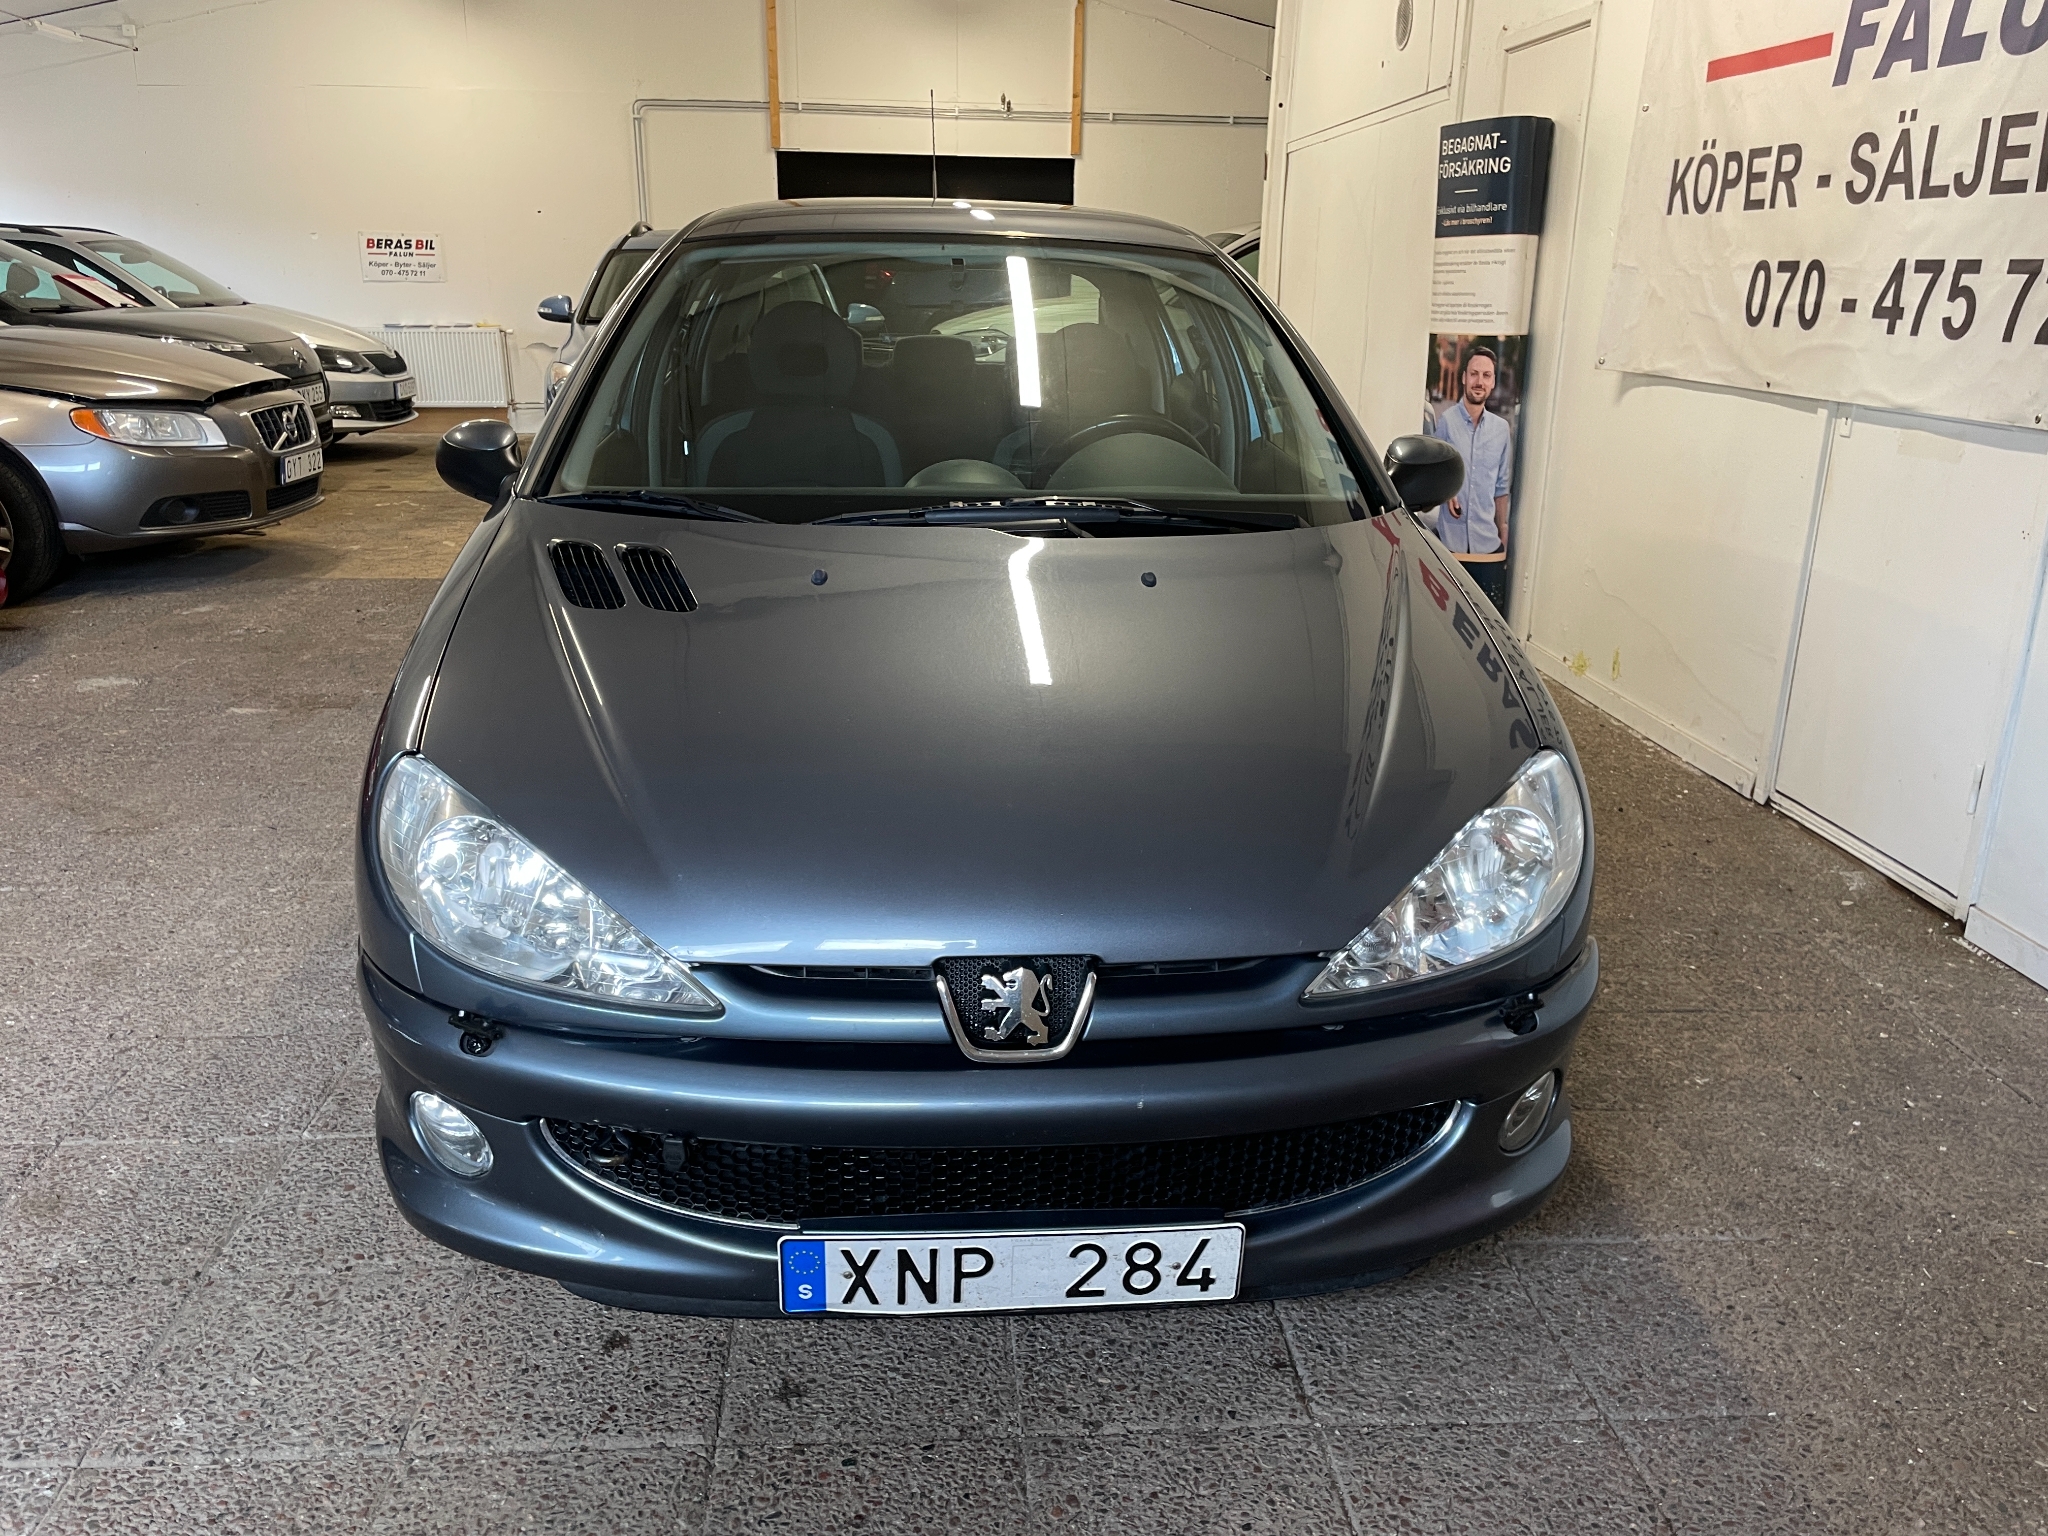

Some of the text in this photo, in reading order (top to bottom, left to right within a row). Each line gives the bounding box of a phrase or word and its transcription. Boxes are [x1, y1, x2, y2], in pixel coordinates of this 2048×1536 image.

[1442, 132, 1508, 156] BEGAGNAT-
[1439, 156, 1512, 179] FÖRSÄKRING
[1666, 108, 2048, 216] KÖPER - SÄLJE
[366, 238, 435, 251] BERAS BIL
[394, 261, 412, 270] Byter
[417, 261, 437, 270] Säljer
[1745, 258, 2048, 345] 070 - 475 7
[287, 451, 322, 479] GYT 322
[797, 1238, 1216, 1306] S XNP 284
